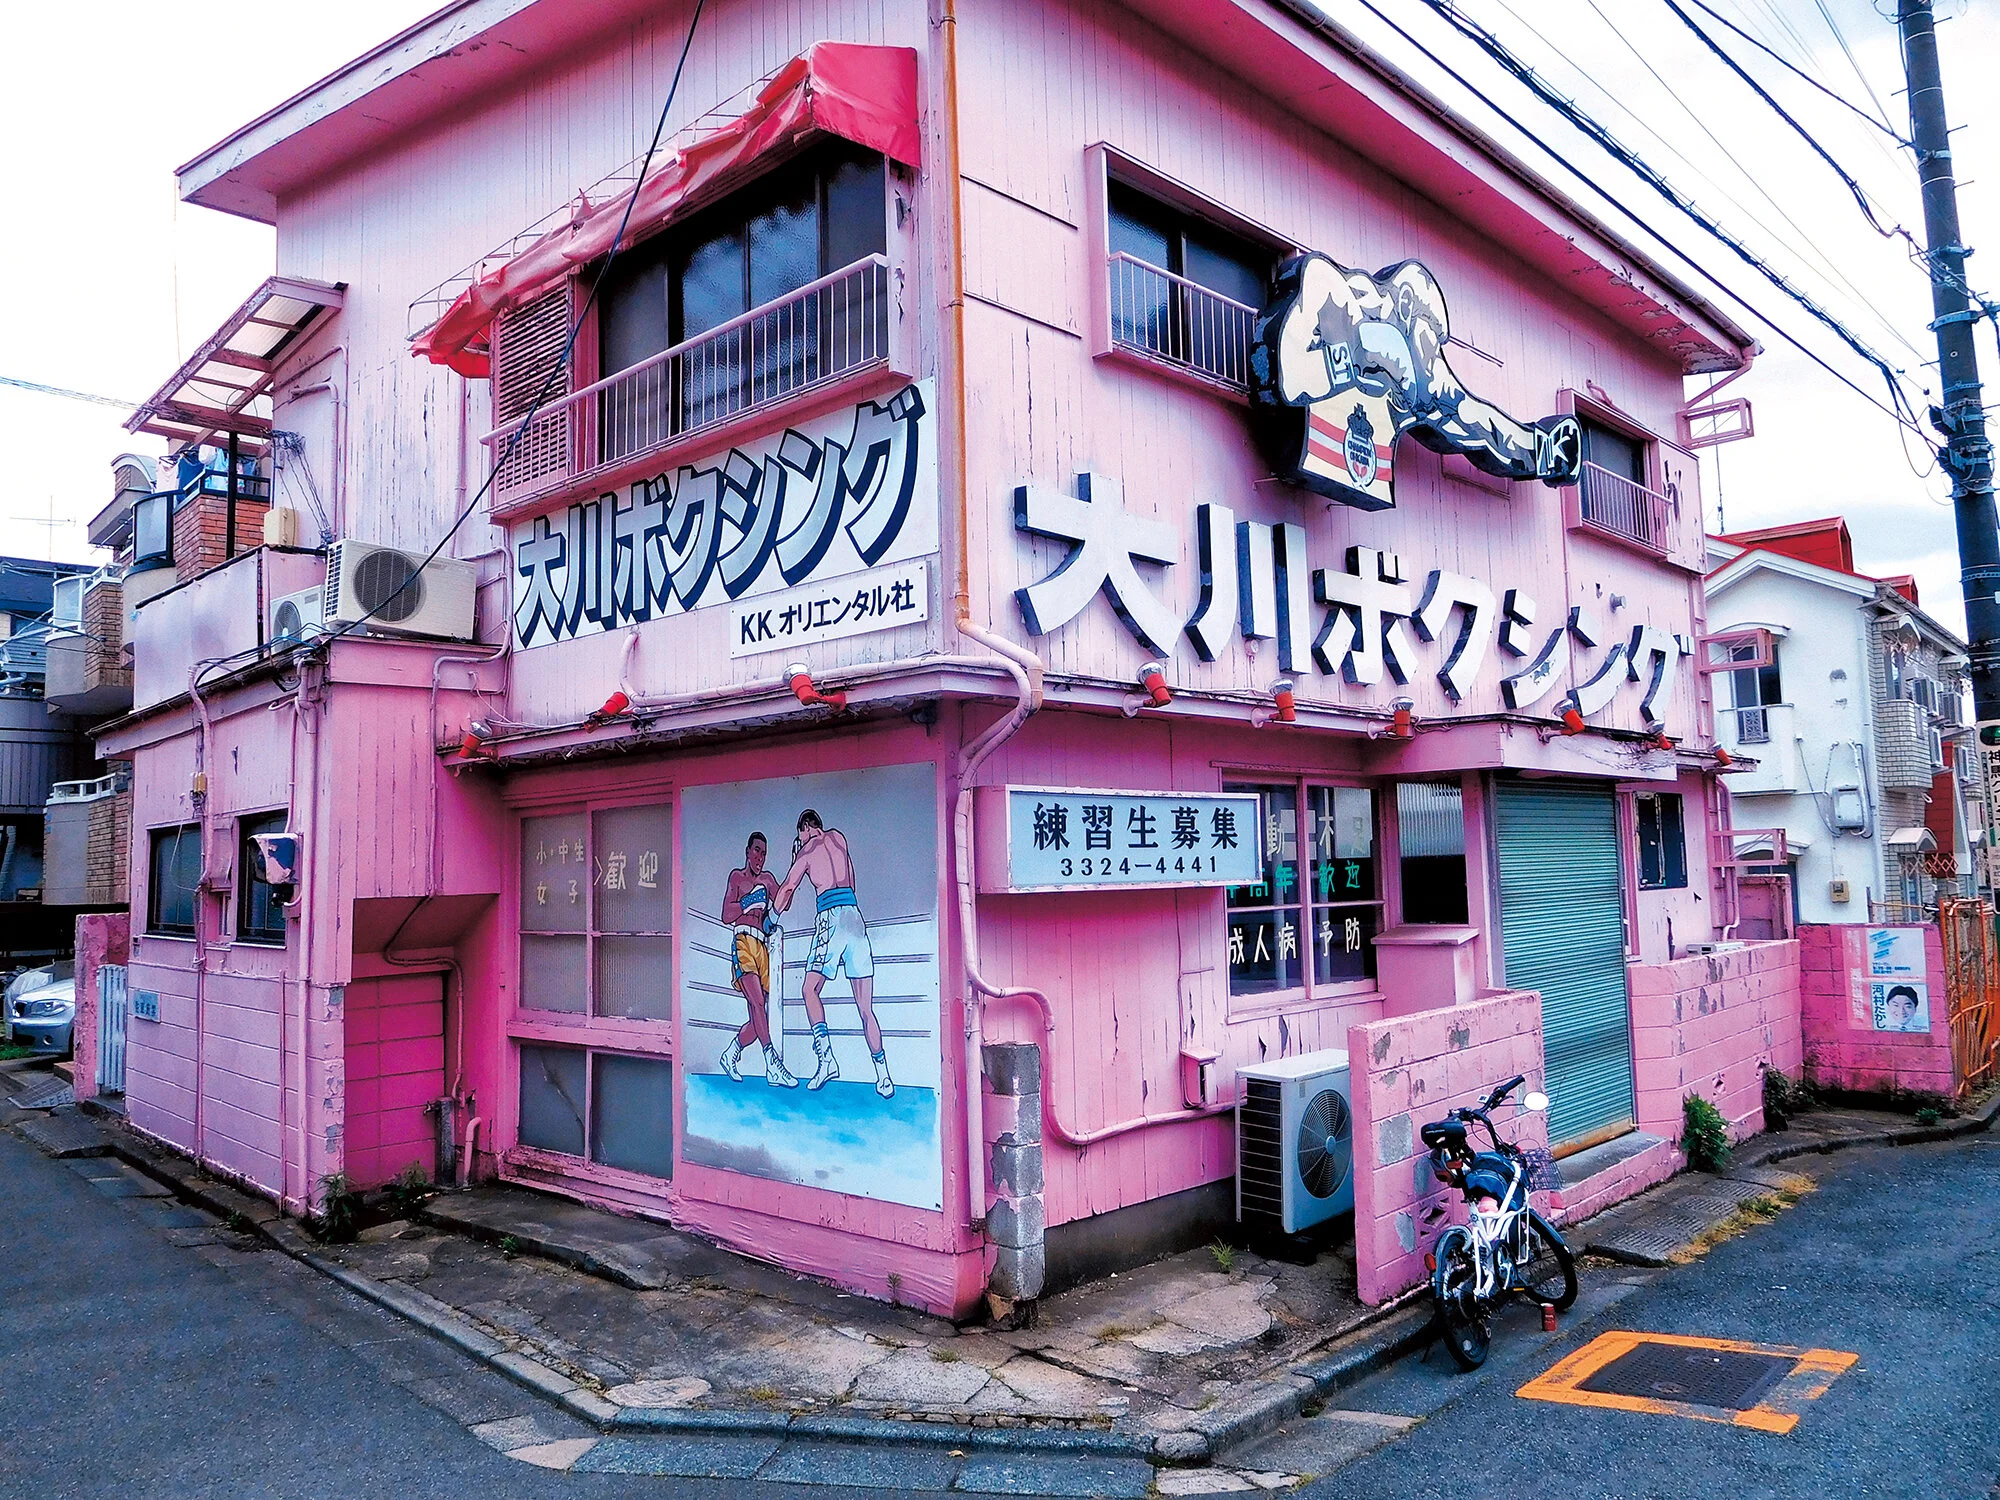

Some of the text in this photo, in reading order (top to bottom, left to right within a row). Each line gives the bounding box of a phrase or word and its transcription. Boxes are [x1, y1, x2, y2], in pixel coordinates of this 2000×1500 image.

[514, 383, 926, 649] 大川ボクシング
[1013, 472, 1695, 722] 大川ボクシング
[1032, 801, 1239, 852] 練習生募集
[1060, 855, 1218, 878] 3324-4441
